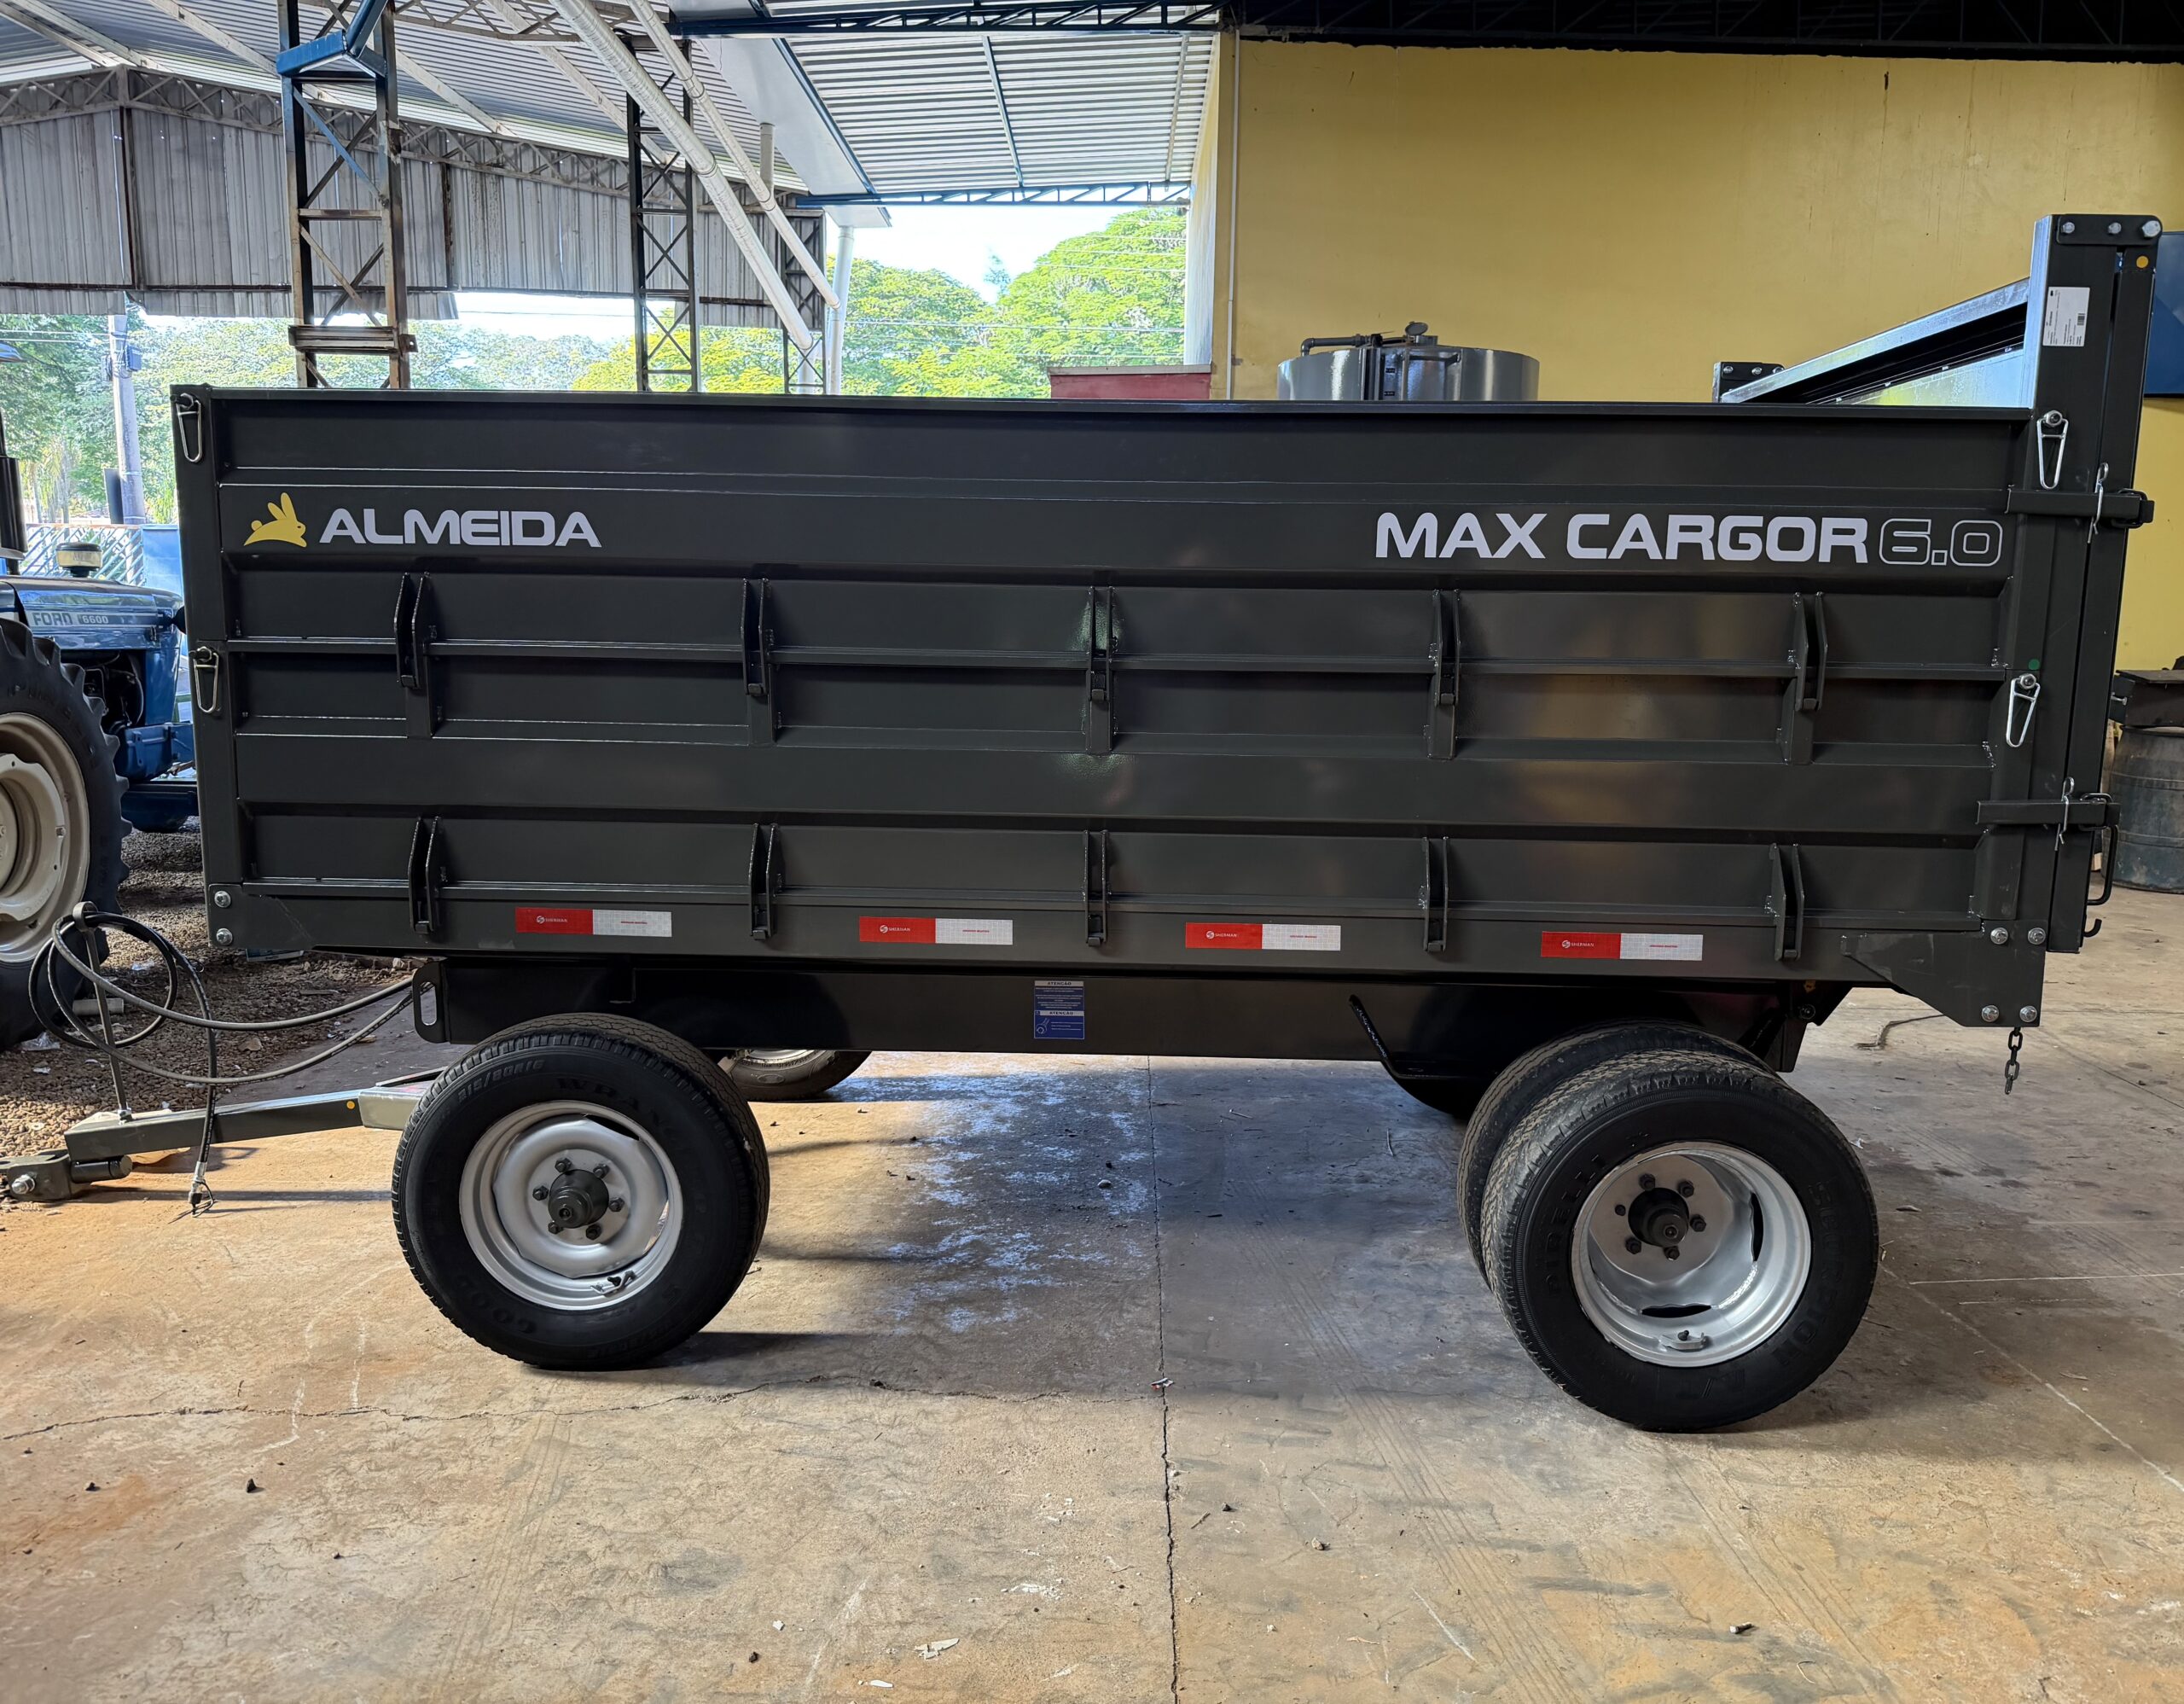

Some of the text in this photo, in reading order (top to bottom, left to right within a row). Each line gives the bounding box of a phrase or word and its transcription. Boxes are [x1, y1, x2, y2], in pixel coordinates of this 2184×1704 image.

[319, 509, 602, 548] ALMEIDA
[1376, 512, 2004, 567] MAX CARGOR 6.0
[32, 613, 108, 625] FORD 6600
[1542, 1154, 1606, 1296] PIRELLI
